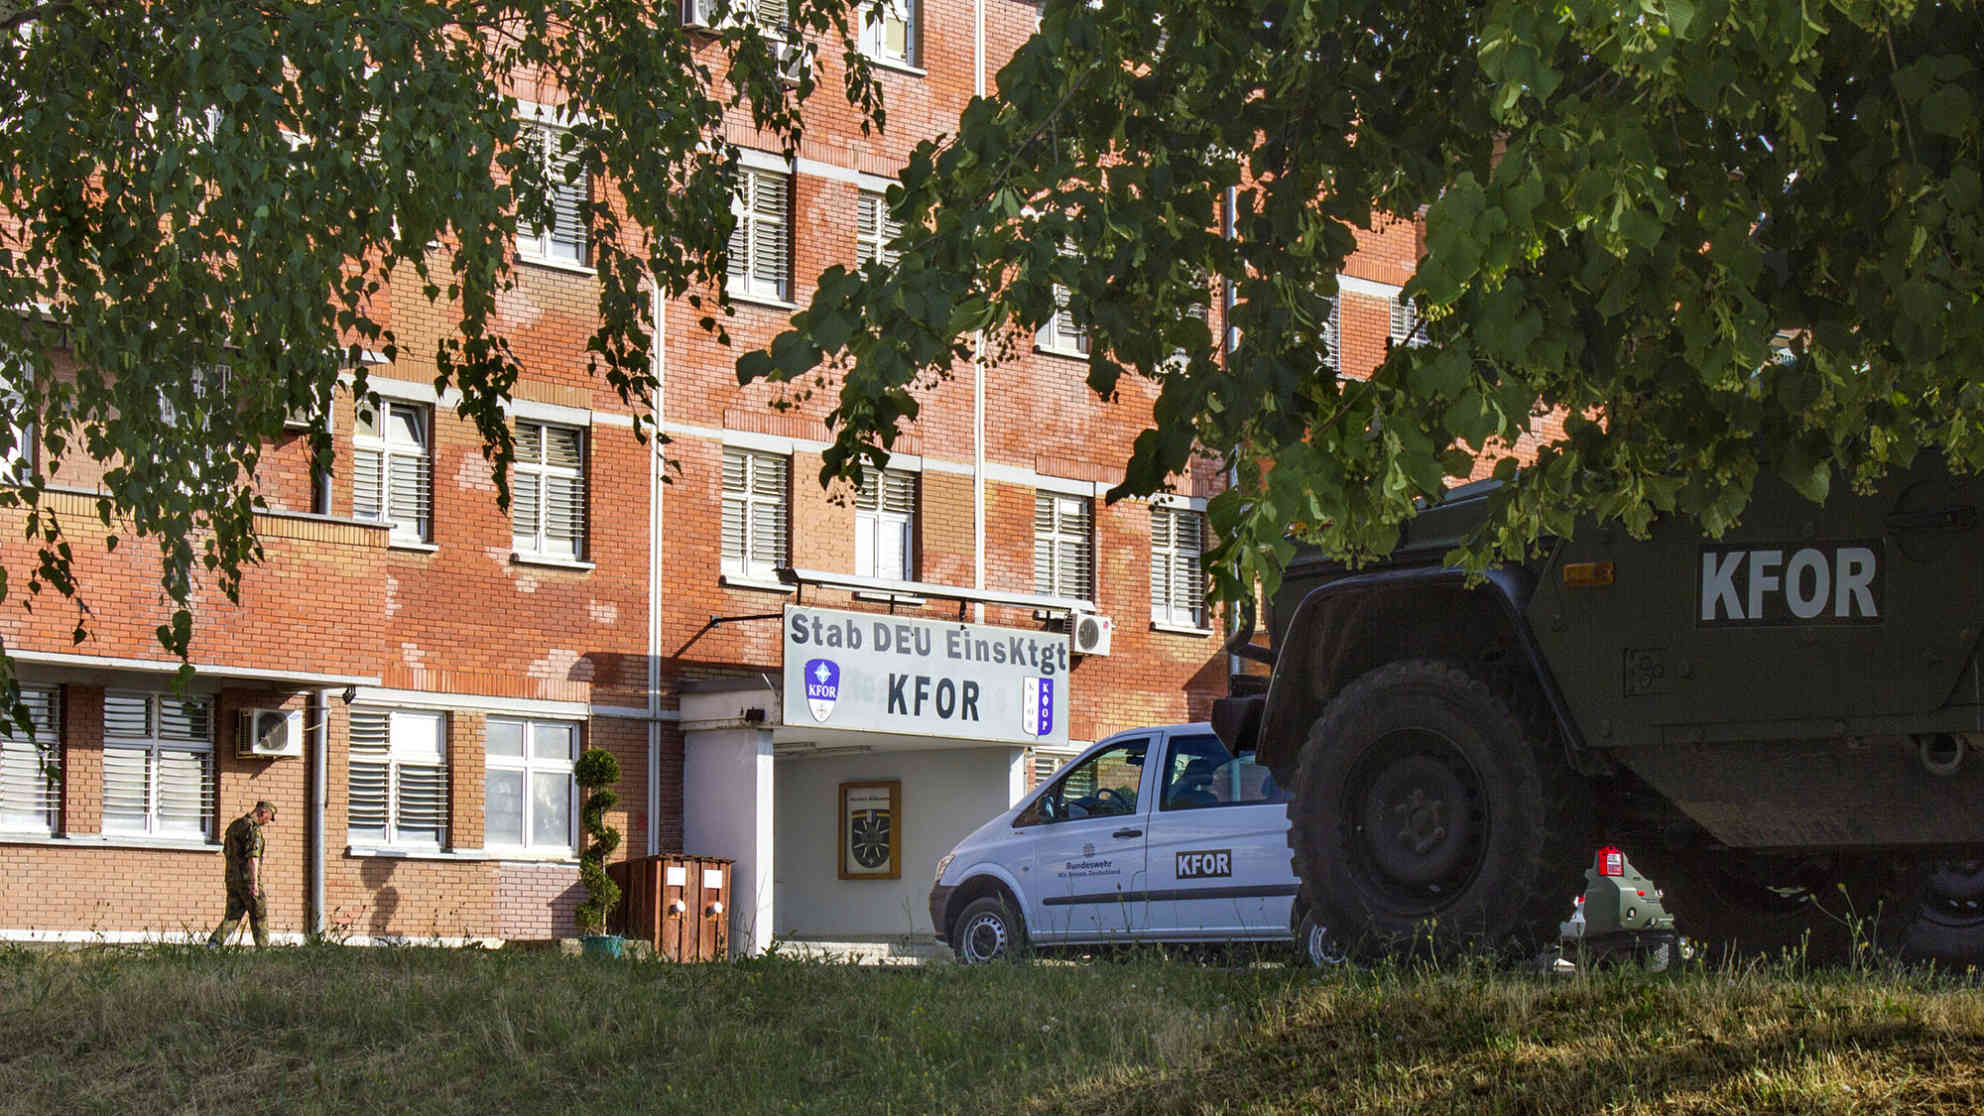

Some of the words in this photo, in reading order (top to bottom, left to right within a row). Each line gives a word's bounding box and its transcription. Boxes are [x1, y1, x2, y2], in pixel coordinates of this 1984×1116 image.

[1701, 547, 1879, 621] KFOR
[791, 613, 863, 650] Stab
[873, 621, 931, 657] DEU
[946, 629, 1067, 676] EinsKtgt
[808, 683, 837, 698] KFOR
[887, 672, 980, 722] KFOR
[1178, 853, 1230, 875] KFOR
